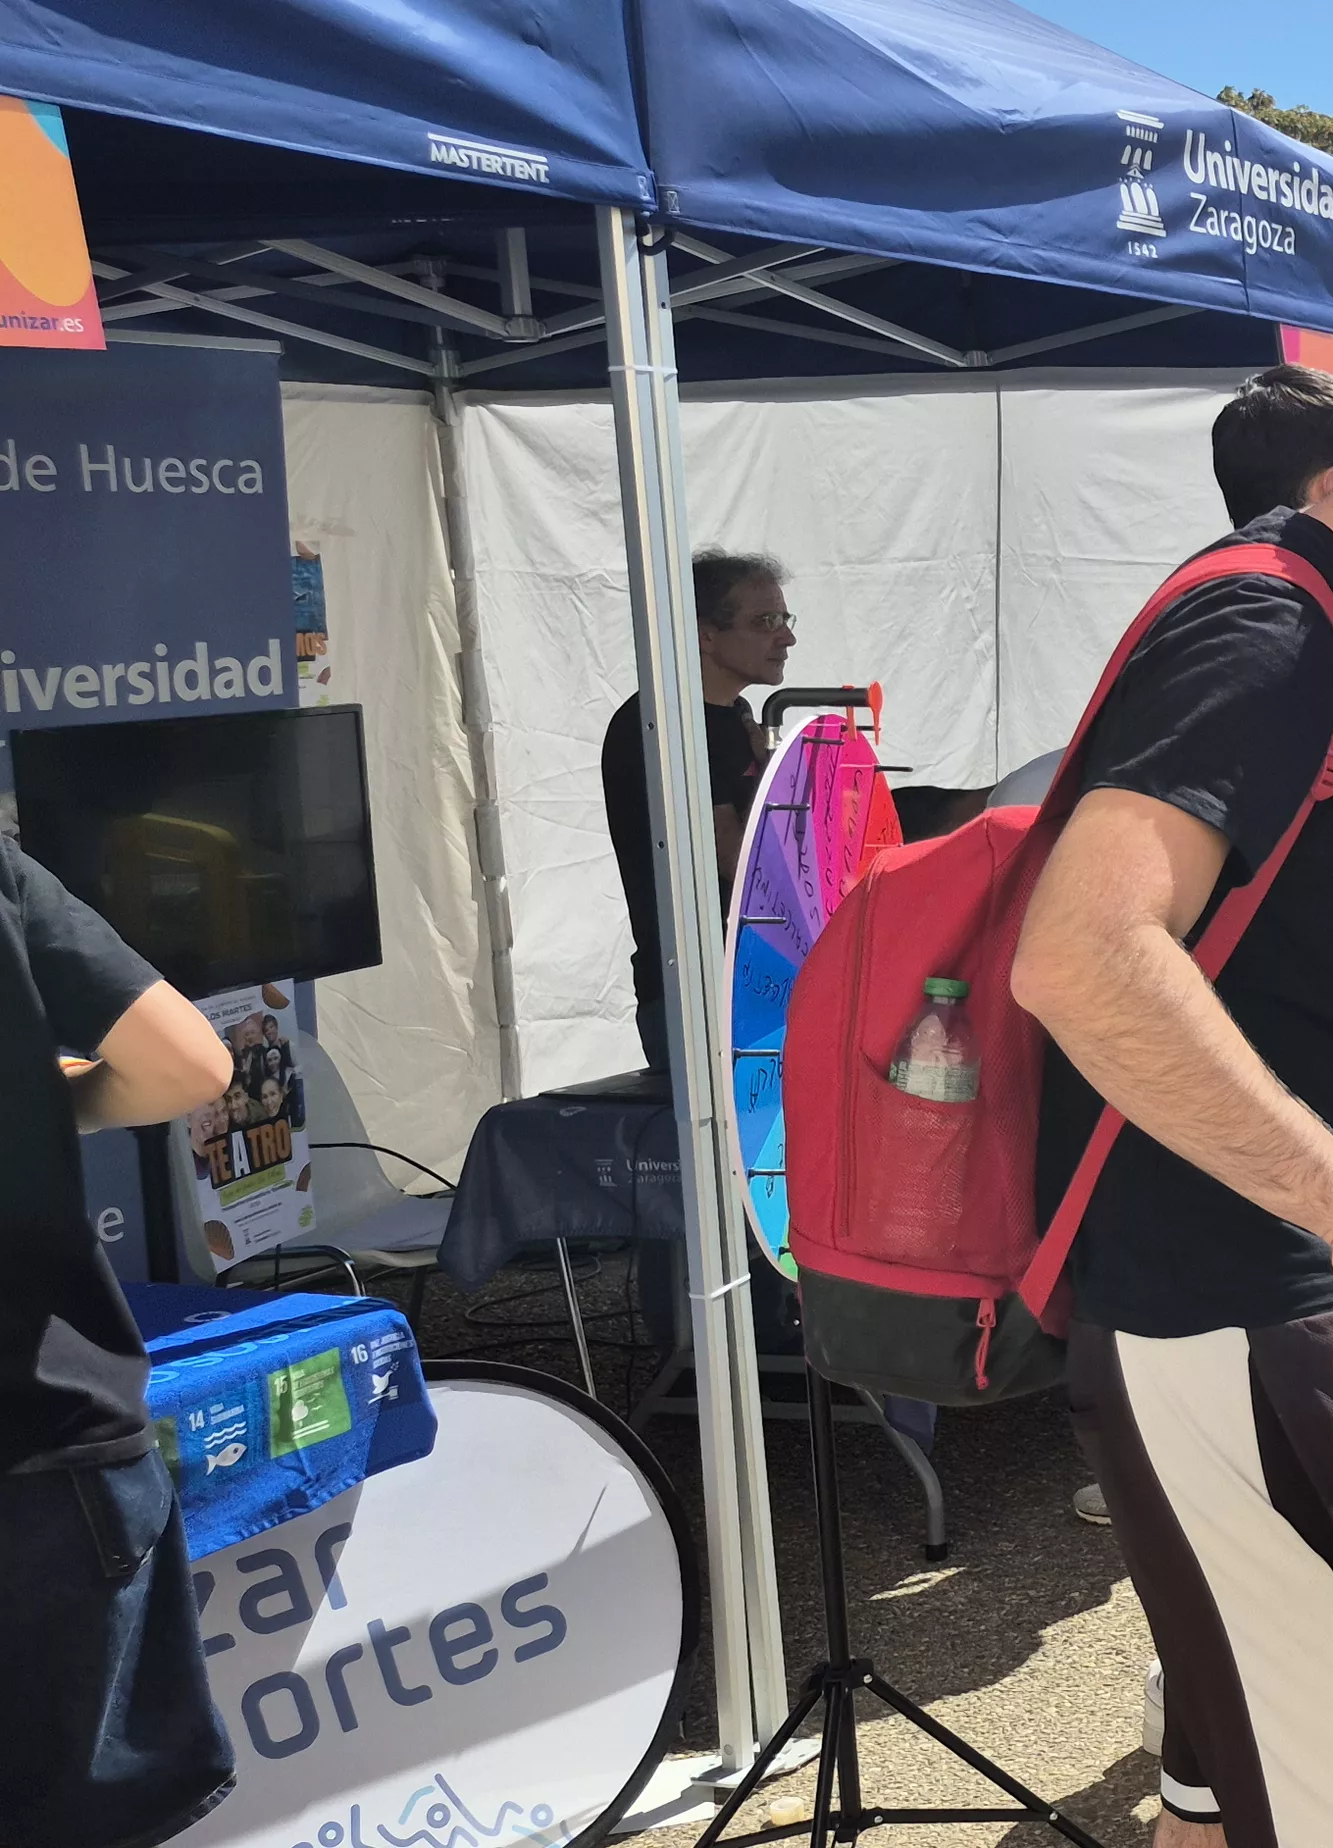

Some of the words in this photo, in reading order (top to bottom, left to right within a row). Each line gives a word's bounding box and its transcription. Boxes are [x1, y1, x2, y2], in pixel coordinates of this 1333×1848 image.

[431, 141, 549, 183] MASTERTENT
[1128, 241, 1158, 258] 1542
[1189, 192, 1295, 255] Zaragoza
[0, 439, 57, 492] de
[80, 444, 263, 494] Huesca
[0, 639, 283, 713] iversidad
[203, 1119, 291, 1184] TEATRO
[351, 1344, 369, 1364] 16
[189, 1410, 204, 1431] 14
[240, 1571, 567, 1759] ortes
